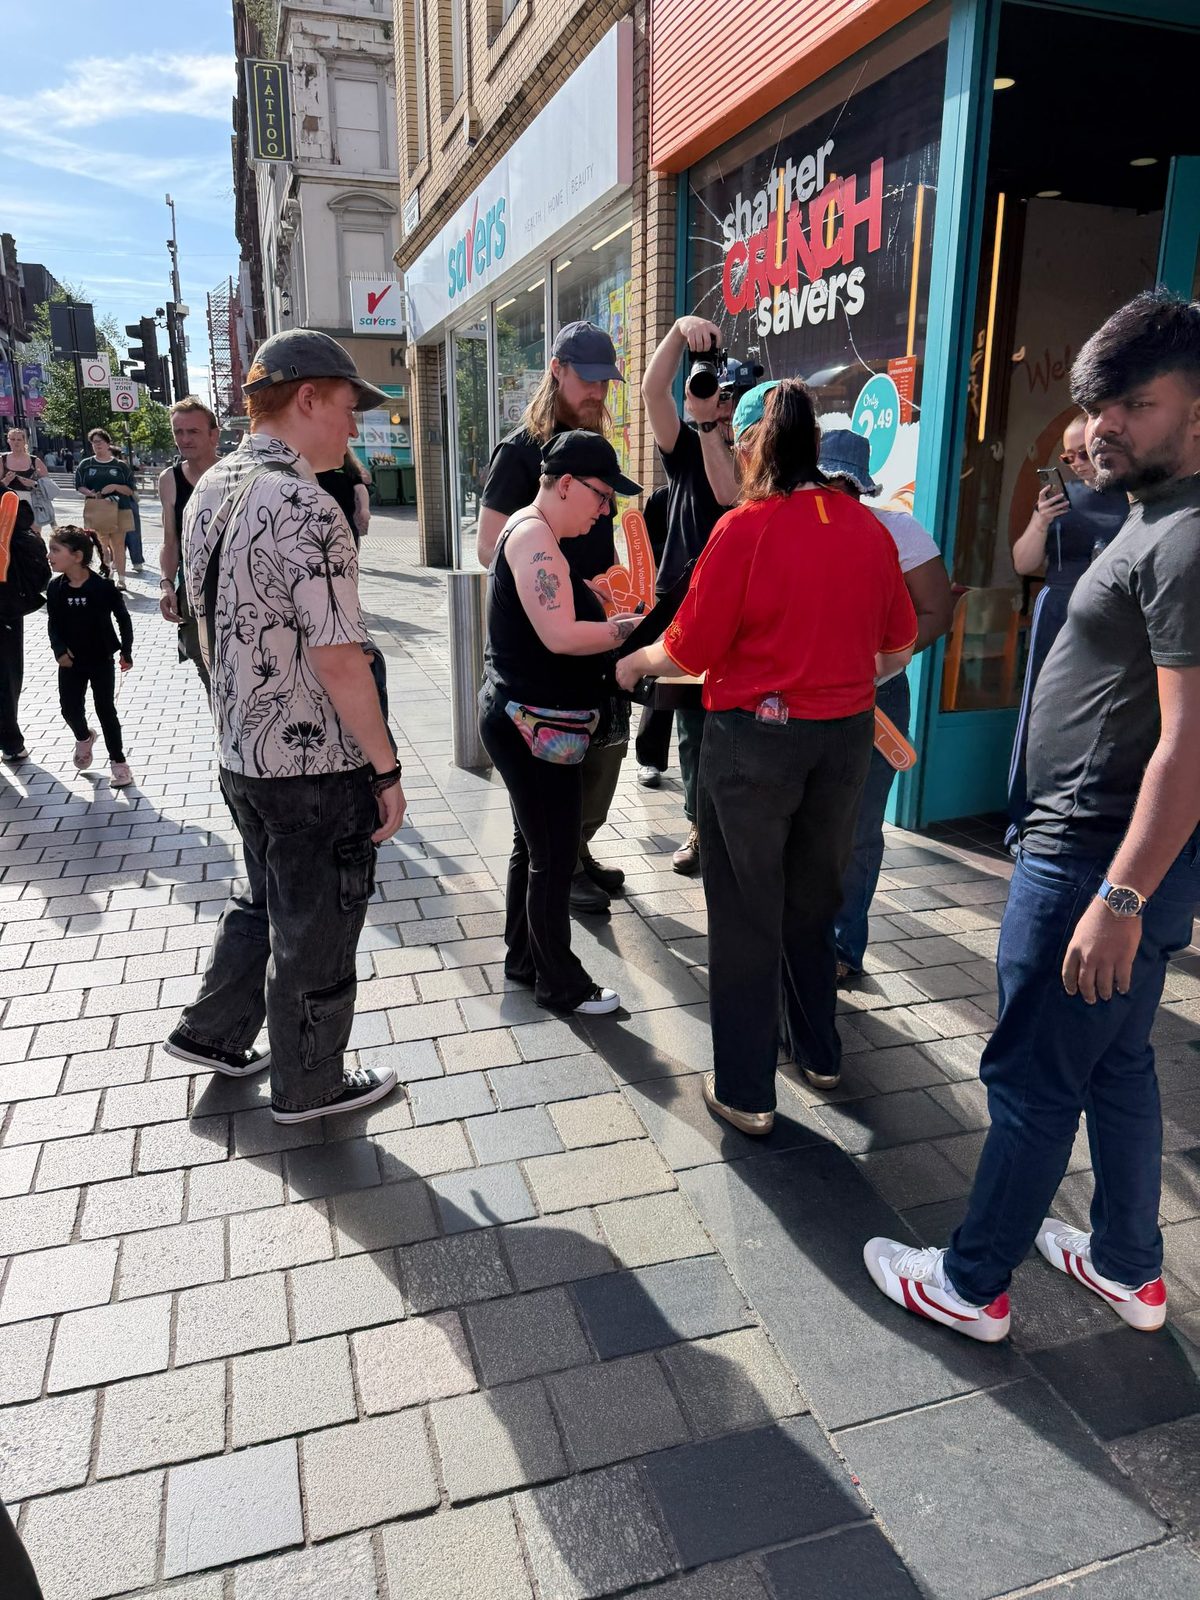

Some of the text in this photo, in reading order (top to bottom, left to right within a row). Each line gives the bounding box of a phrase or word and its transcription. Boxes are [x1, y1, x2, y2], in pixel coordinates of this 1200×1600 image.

[263, 69, 278, 154] TATTOO
[525, 162, 594, 233] HEALTH HOME BEAUTY
[723, 139, 834, 251] shatter
[448, 196, 506, 299] savers
[723, 157, 884, 315] CRUNCH
[359, 315, 397, 326] savers
[757, 266, 866, 337] savers
[863, 393, 879, 409] Only
[633, 540, 640, 550] Up
